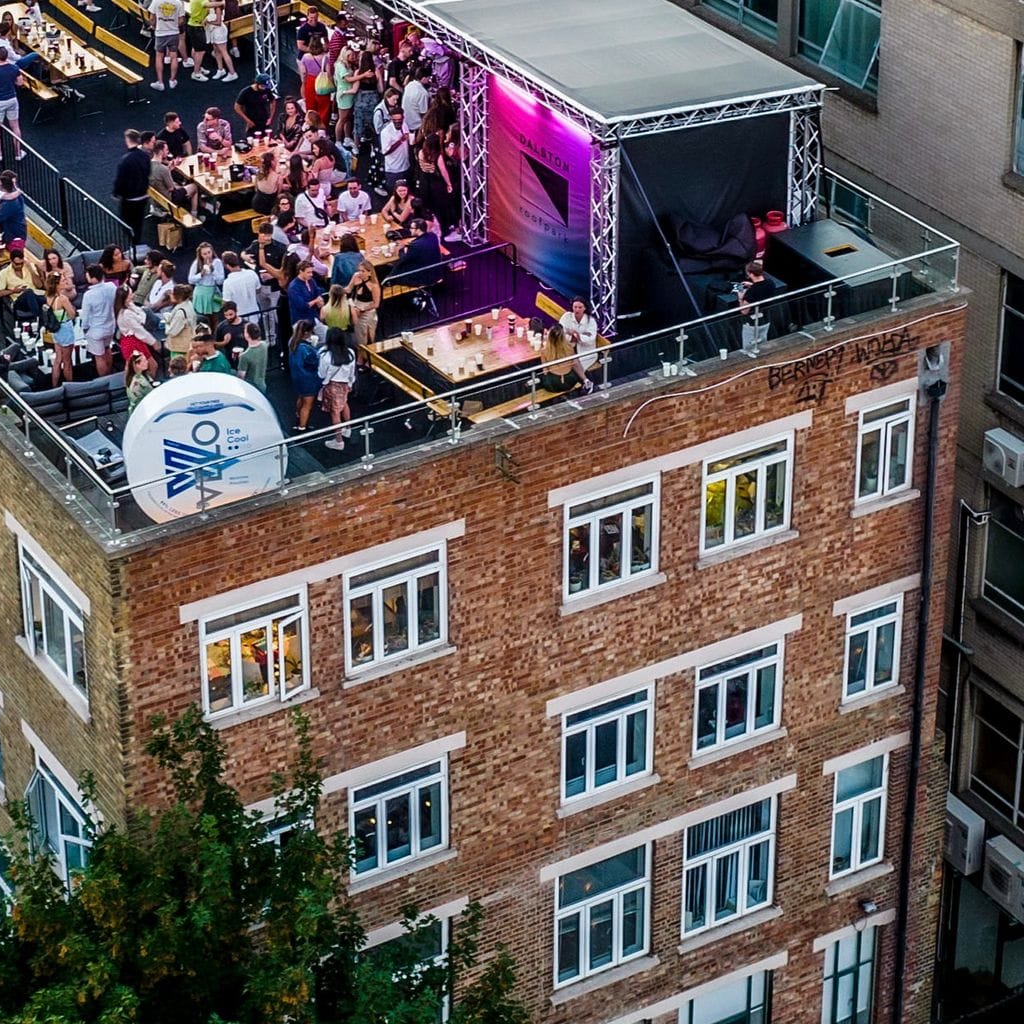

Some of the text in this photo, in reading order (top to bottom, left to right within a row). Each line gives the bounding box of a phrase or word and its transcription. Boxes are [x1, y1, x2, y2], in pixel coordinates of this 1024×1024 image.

[519, 133, 571, 173] DALSTON
[519, 206, 569, 244] roofpark
[226, 427, 241, 436] Ice
[227, 434, 249, 444] Cool
